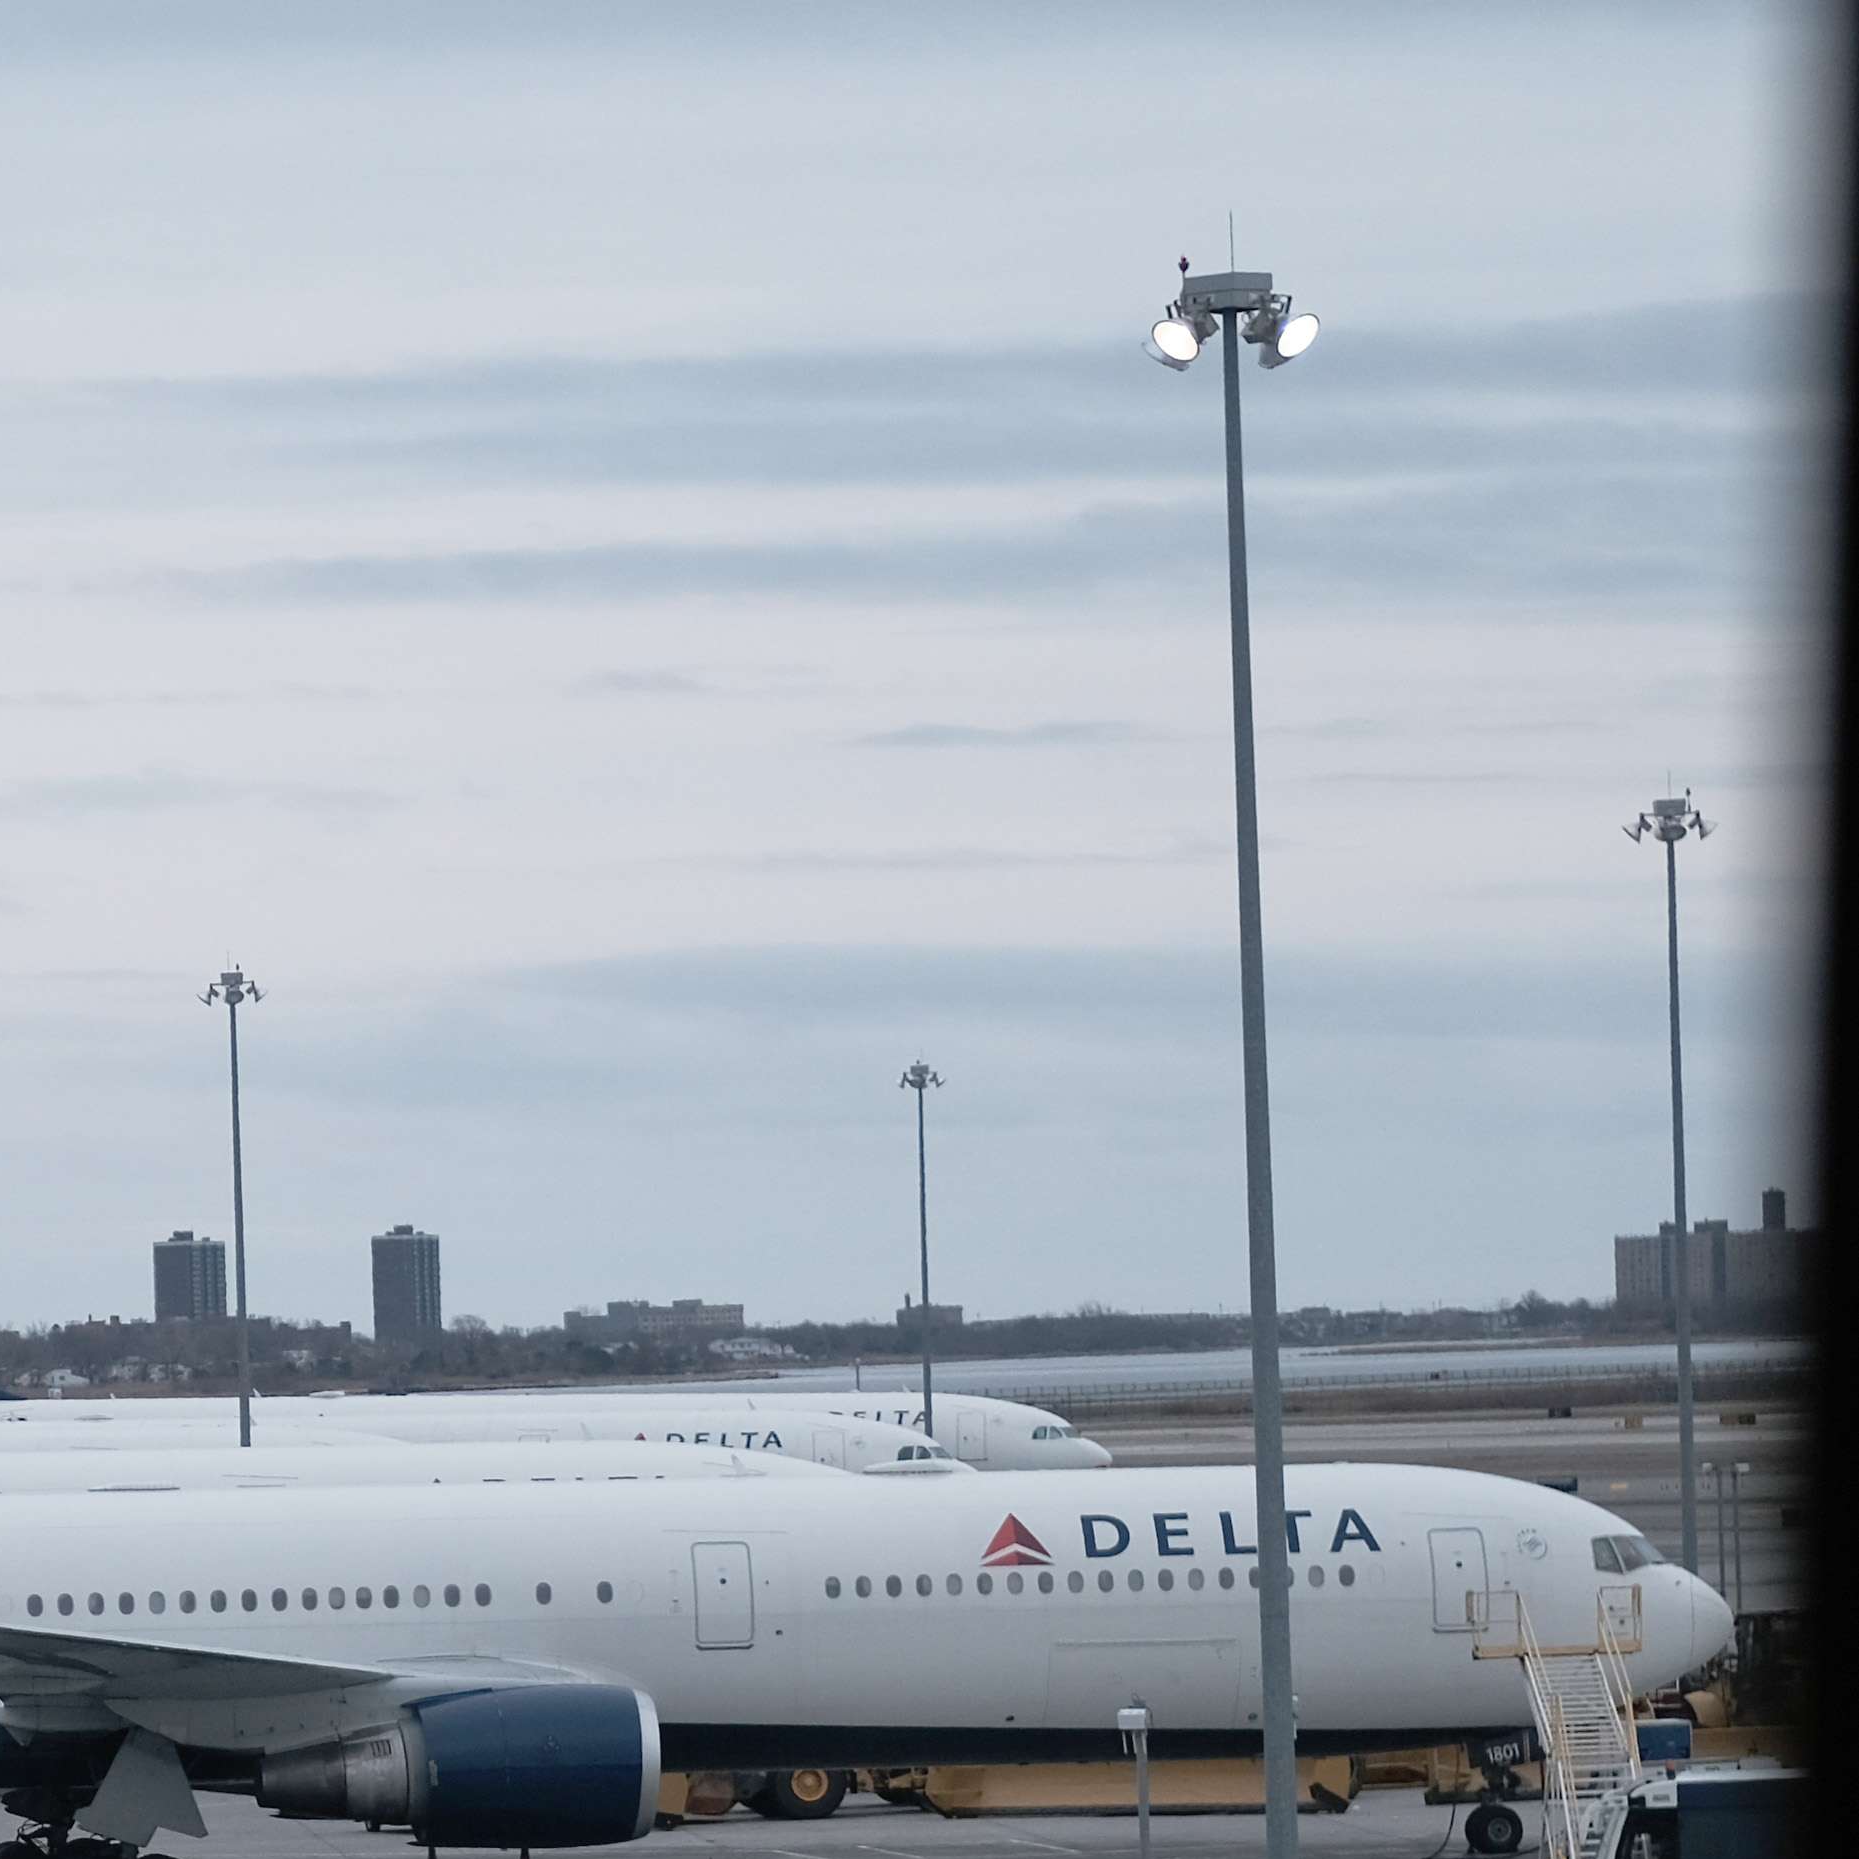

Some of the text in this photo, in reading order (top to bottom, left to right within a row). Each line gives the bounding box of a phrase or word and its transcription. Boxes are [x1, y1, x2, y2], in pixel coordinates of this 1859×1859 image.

[666, 1431, 784, 1449] DELTA
[1080, 1509, 1382, 1558] DELTA
[1487, 1743, 1521, 1764] 1801
